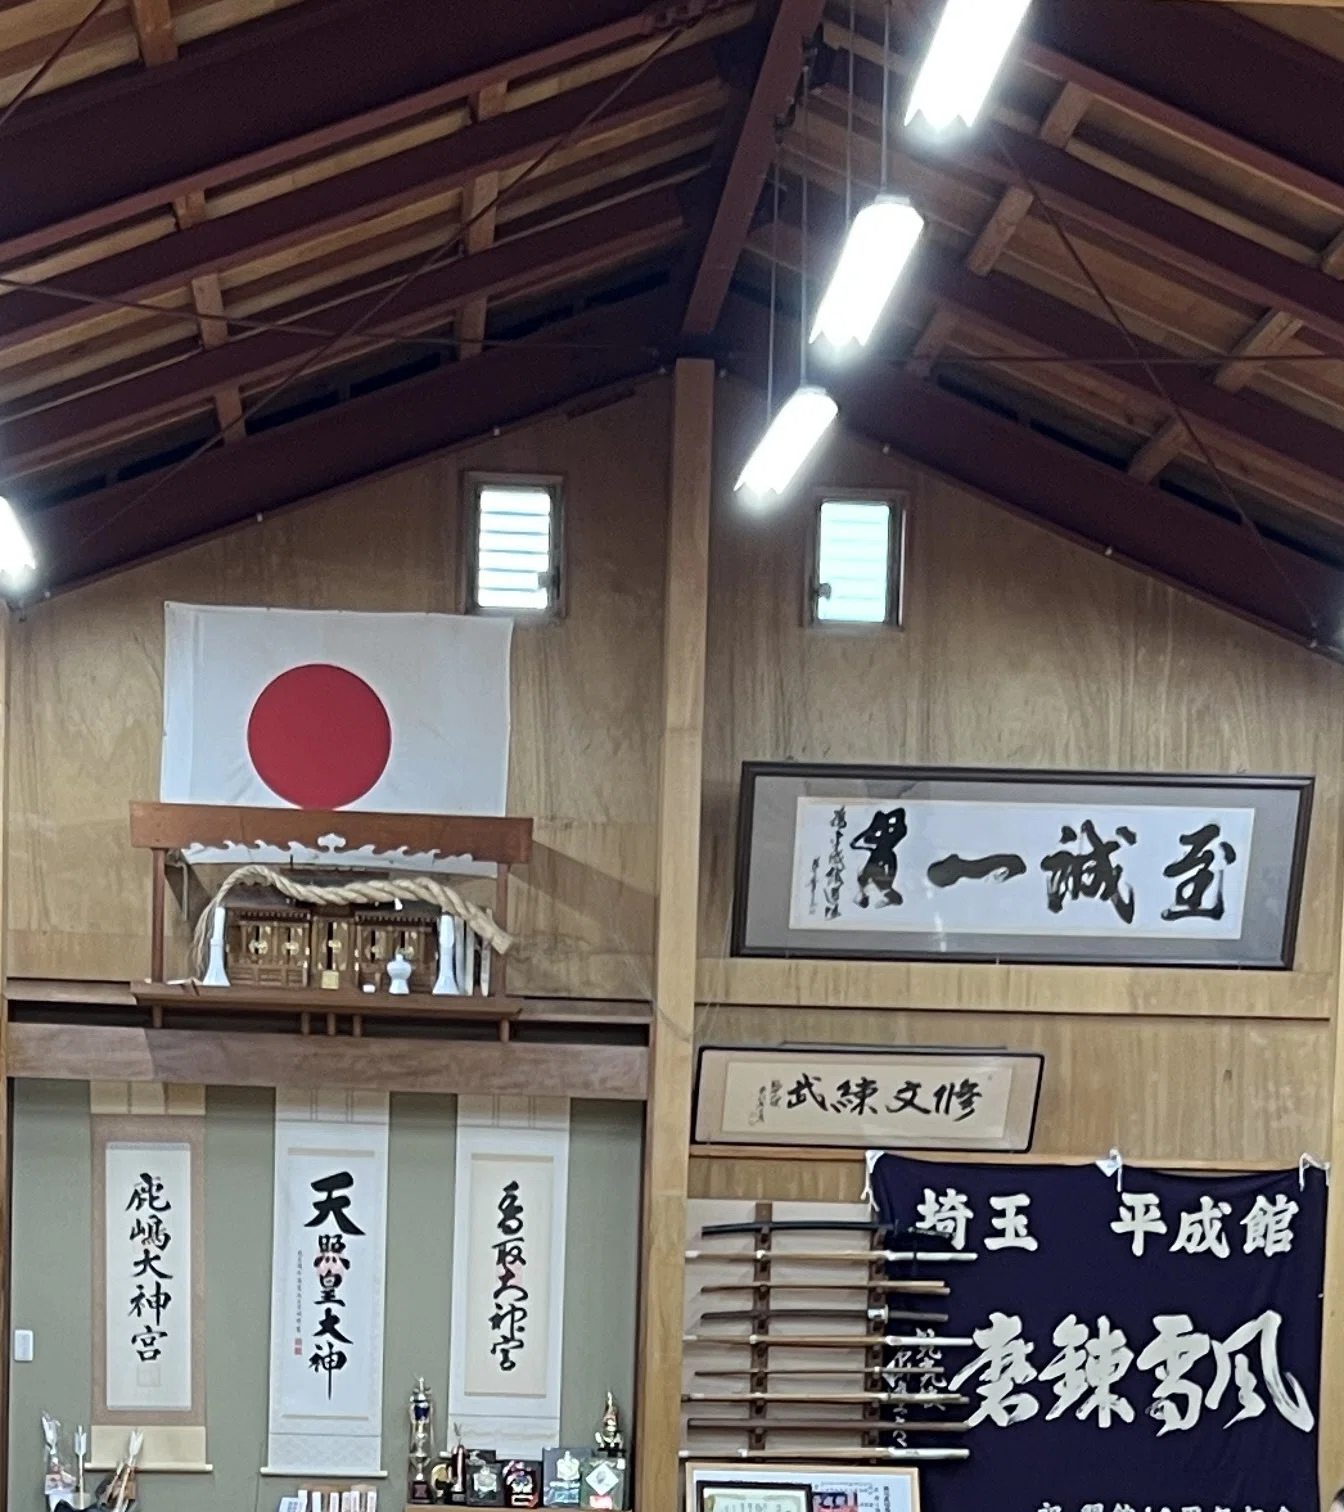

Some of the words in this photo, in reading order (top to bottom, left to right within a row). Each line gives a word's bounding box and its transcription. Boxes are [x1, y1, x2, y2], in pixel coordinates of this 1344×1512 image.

[304, 1171, 366, 1400] 天照皇大神
[914, 1187, 1039, 1252] 埼玉
[1110, 1192, 1300, 1258] 平成館
